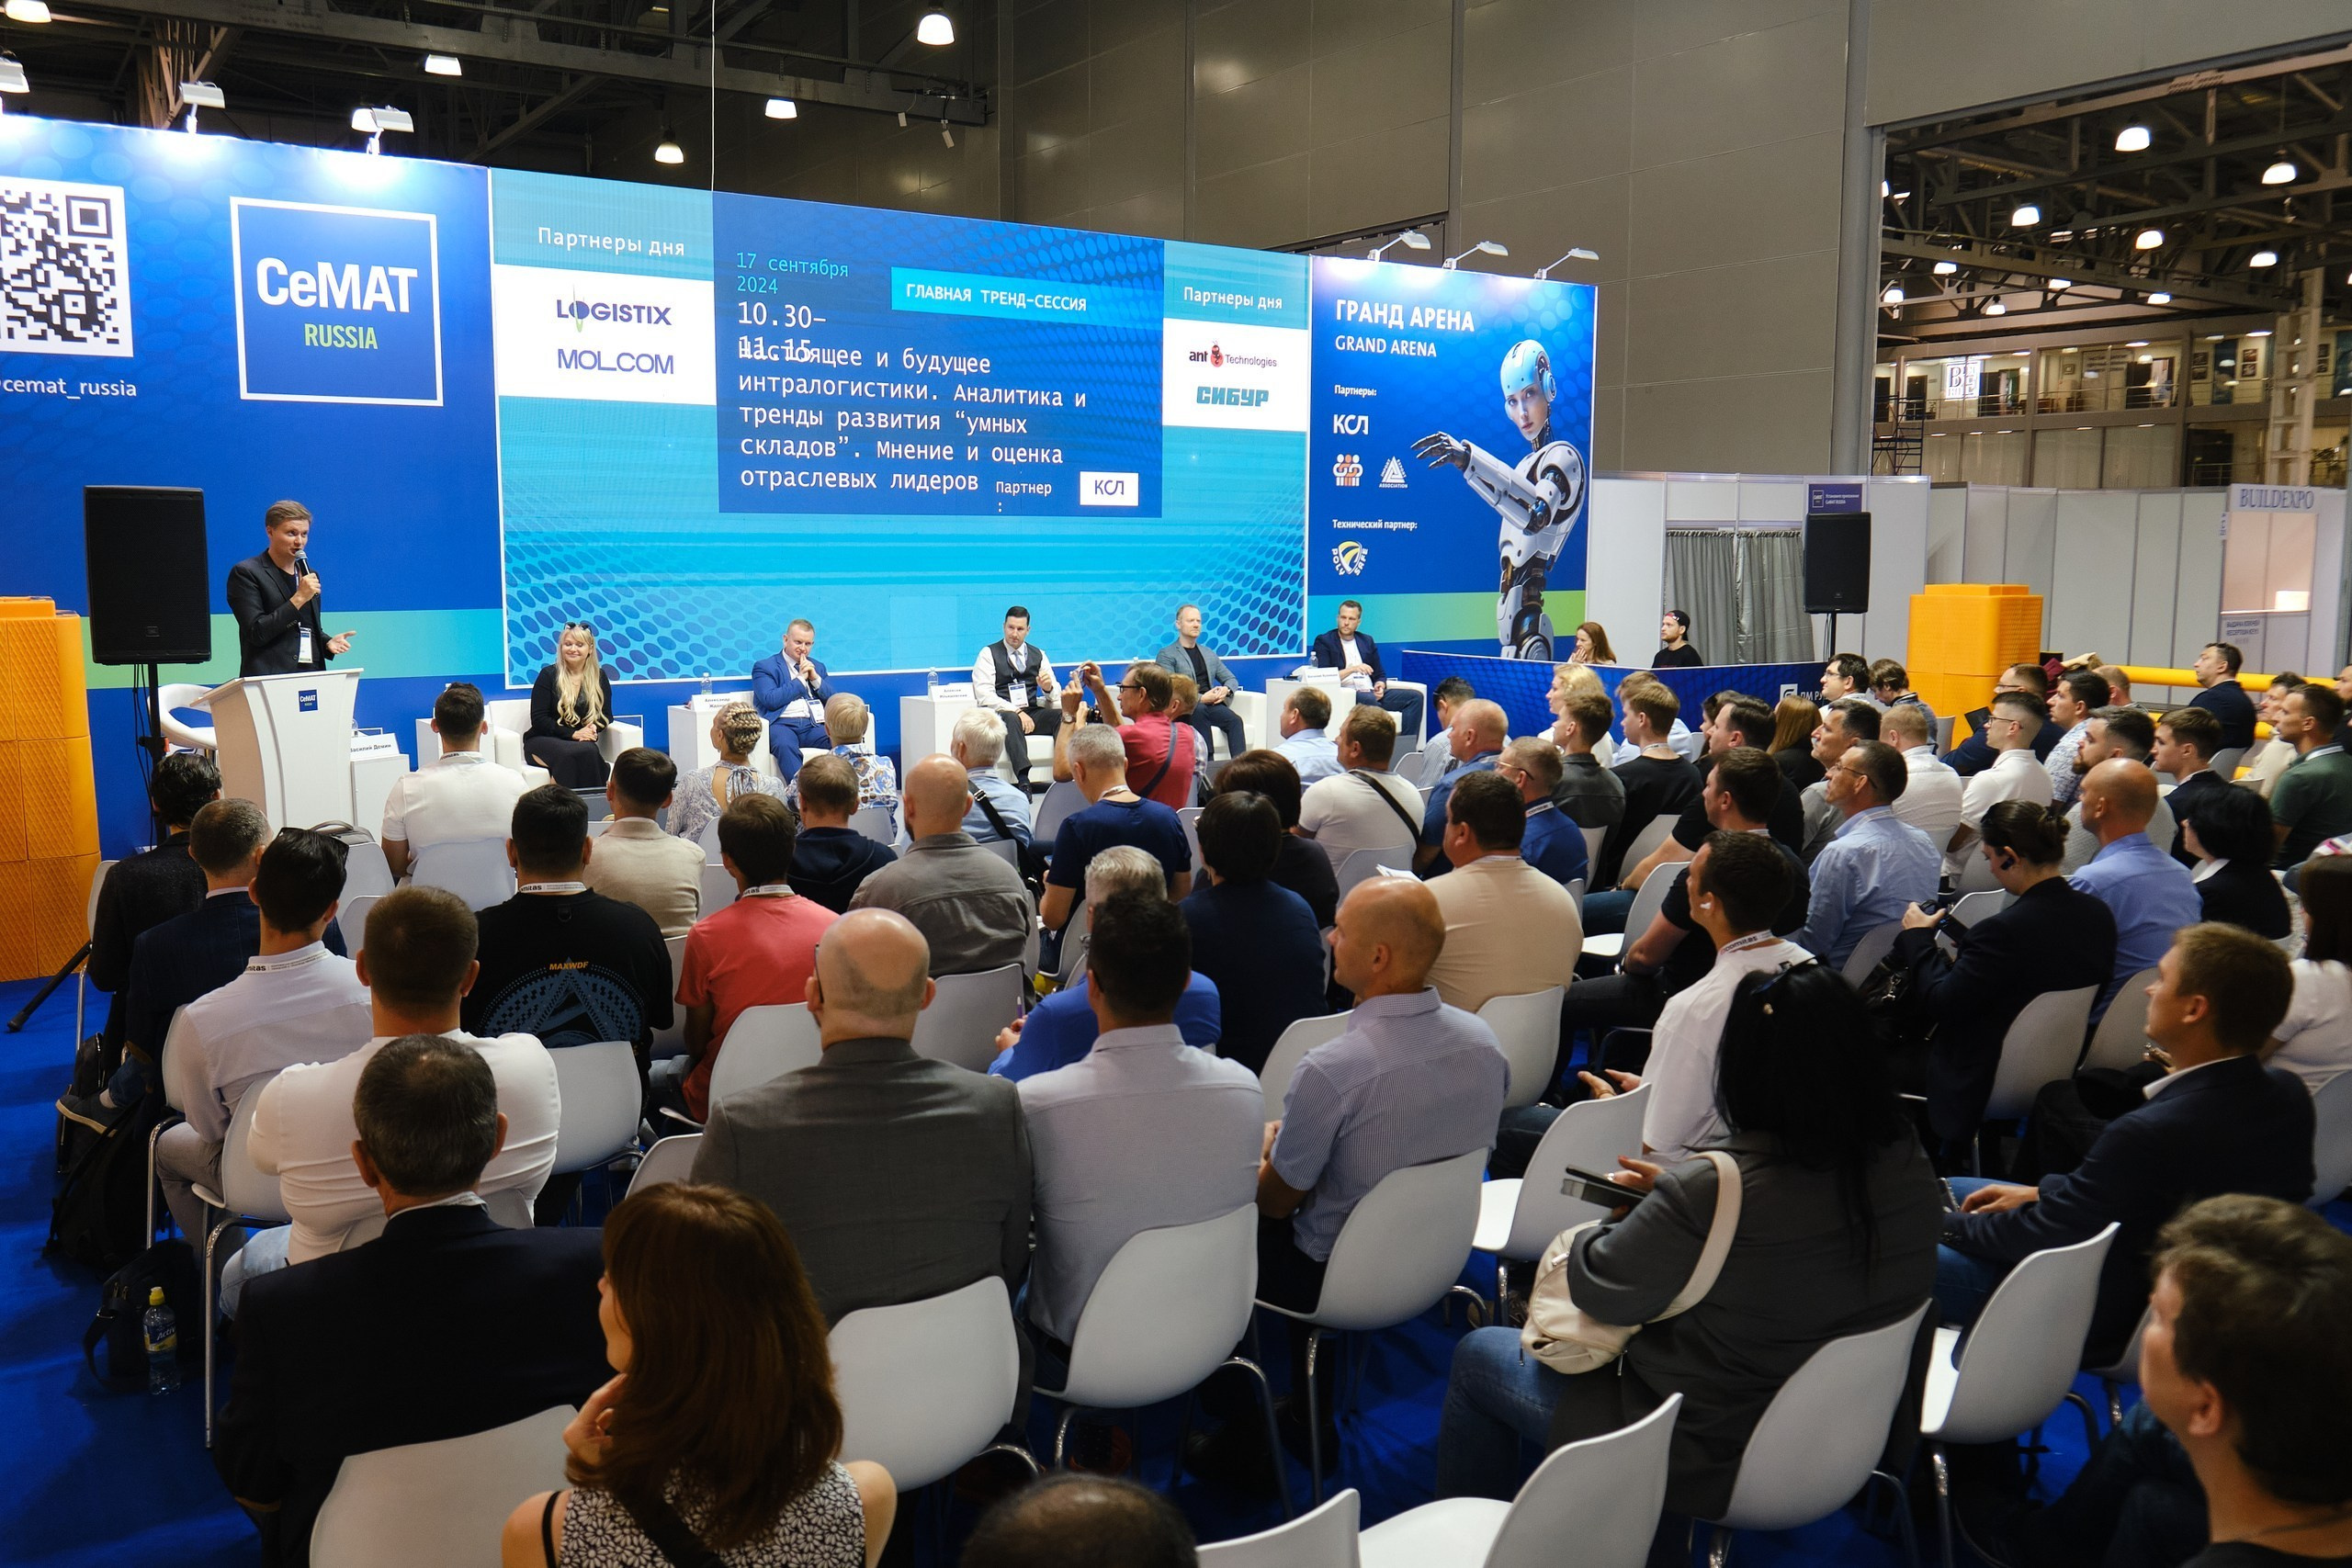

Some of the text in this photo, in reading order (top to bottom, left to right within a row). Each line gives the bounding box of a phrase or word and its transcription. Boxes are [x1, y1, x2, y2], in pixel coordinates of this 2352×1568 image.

[538, 227, 684, 256] Партнеры дня
[737, 253, 849, 279] 17 сентября
[256, 257, 418, 313] CeMAT
[737, 276, 778, 294] 2024
[906, 284, 1087, 311] ГЛАВНАЯ ТРЕНД-СЕССИЯ
[1183, 286, 1283, 310] Партнеры дня
[557, 299, 672, 325] LOGISTIX
[1336, 299, 1475, 332] ГРАНД АРЕНА
[304, 323, 379, 349] RUSSIA
[1335, 334, 1437, 357] GRAND ARENA
[876, 351, 888, 367] и
[902, 347, 990, 376] будущее
[1189, 351, 1277, 368] ant Technologies
[0, 378, 137, 400] cemat_russia
[739, 375, 1086, 407] интралогистики. Аналитика и
[1196, 386, 1269, 407] СИБУР
[1334, 384, 1377, 398] Партнеры:
[739, 406, 823, 428] тренды
[837, 410, 940, 431] развития
[1333, 413, 1369, 435] КСЛ
[876, 441, 954, 460] Мнение
[967, 446, 978, 461] и
[991, 446, 1063, 465] оценка
[741, 469, 978, 494] отраслевых лидеров
[996, 481, 1052, 497] Партнер
[1094, 479, 1125, 496] КСЛ
[2240, 489, 2314, 510] BUILDEXPO
[1332, 519, 1418, 532] Технический партнер:
